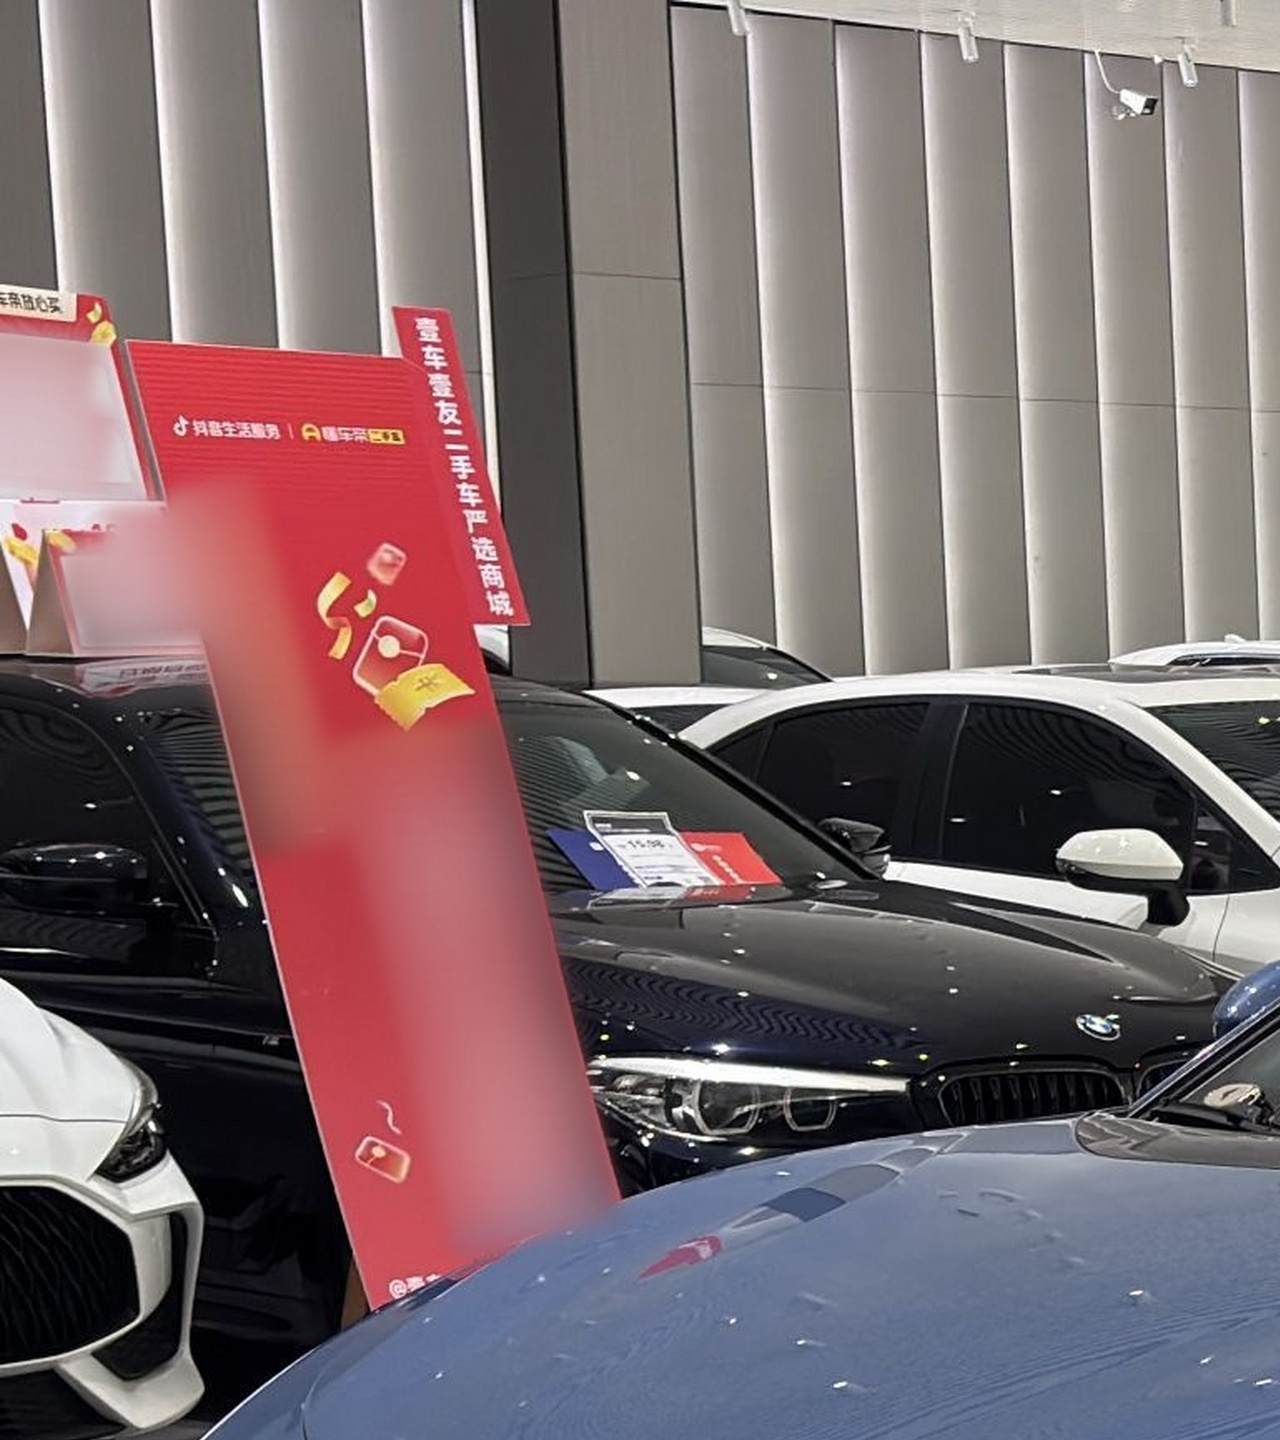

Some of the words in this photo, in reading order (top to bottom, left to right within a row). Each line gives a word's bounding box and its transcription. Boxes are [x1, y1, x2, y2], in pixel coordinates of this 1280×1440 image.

[193, 420, 281, 439] 抖音生活服务
[415, 317, 513, 616] 壹车壹友二手车严选商城
